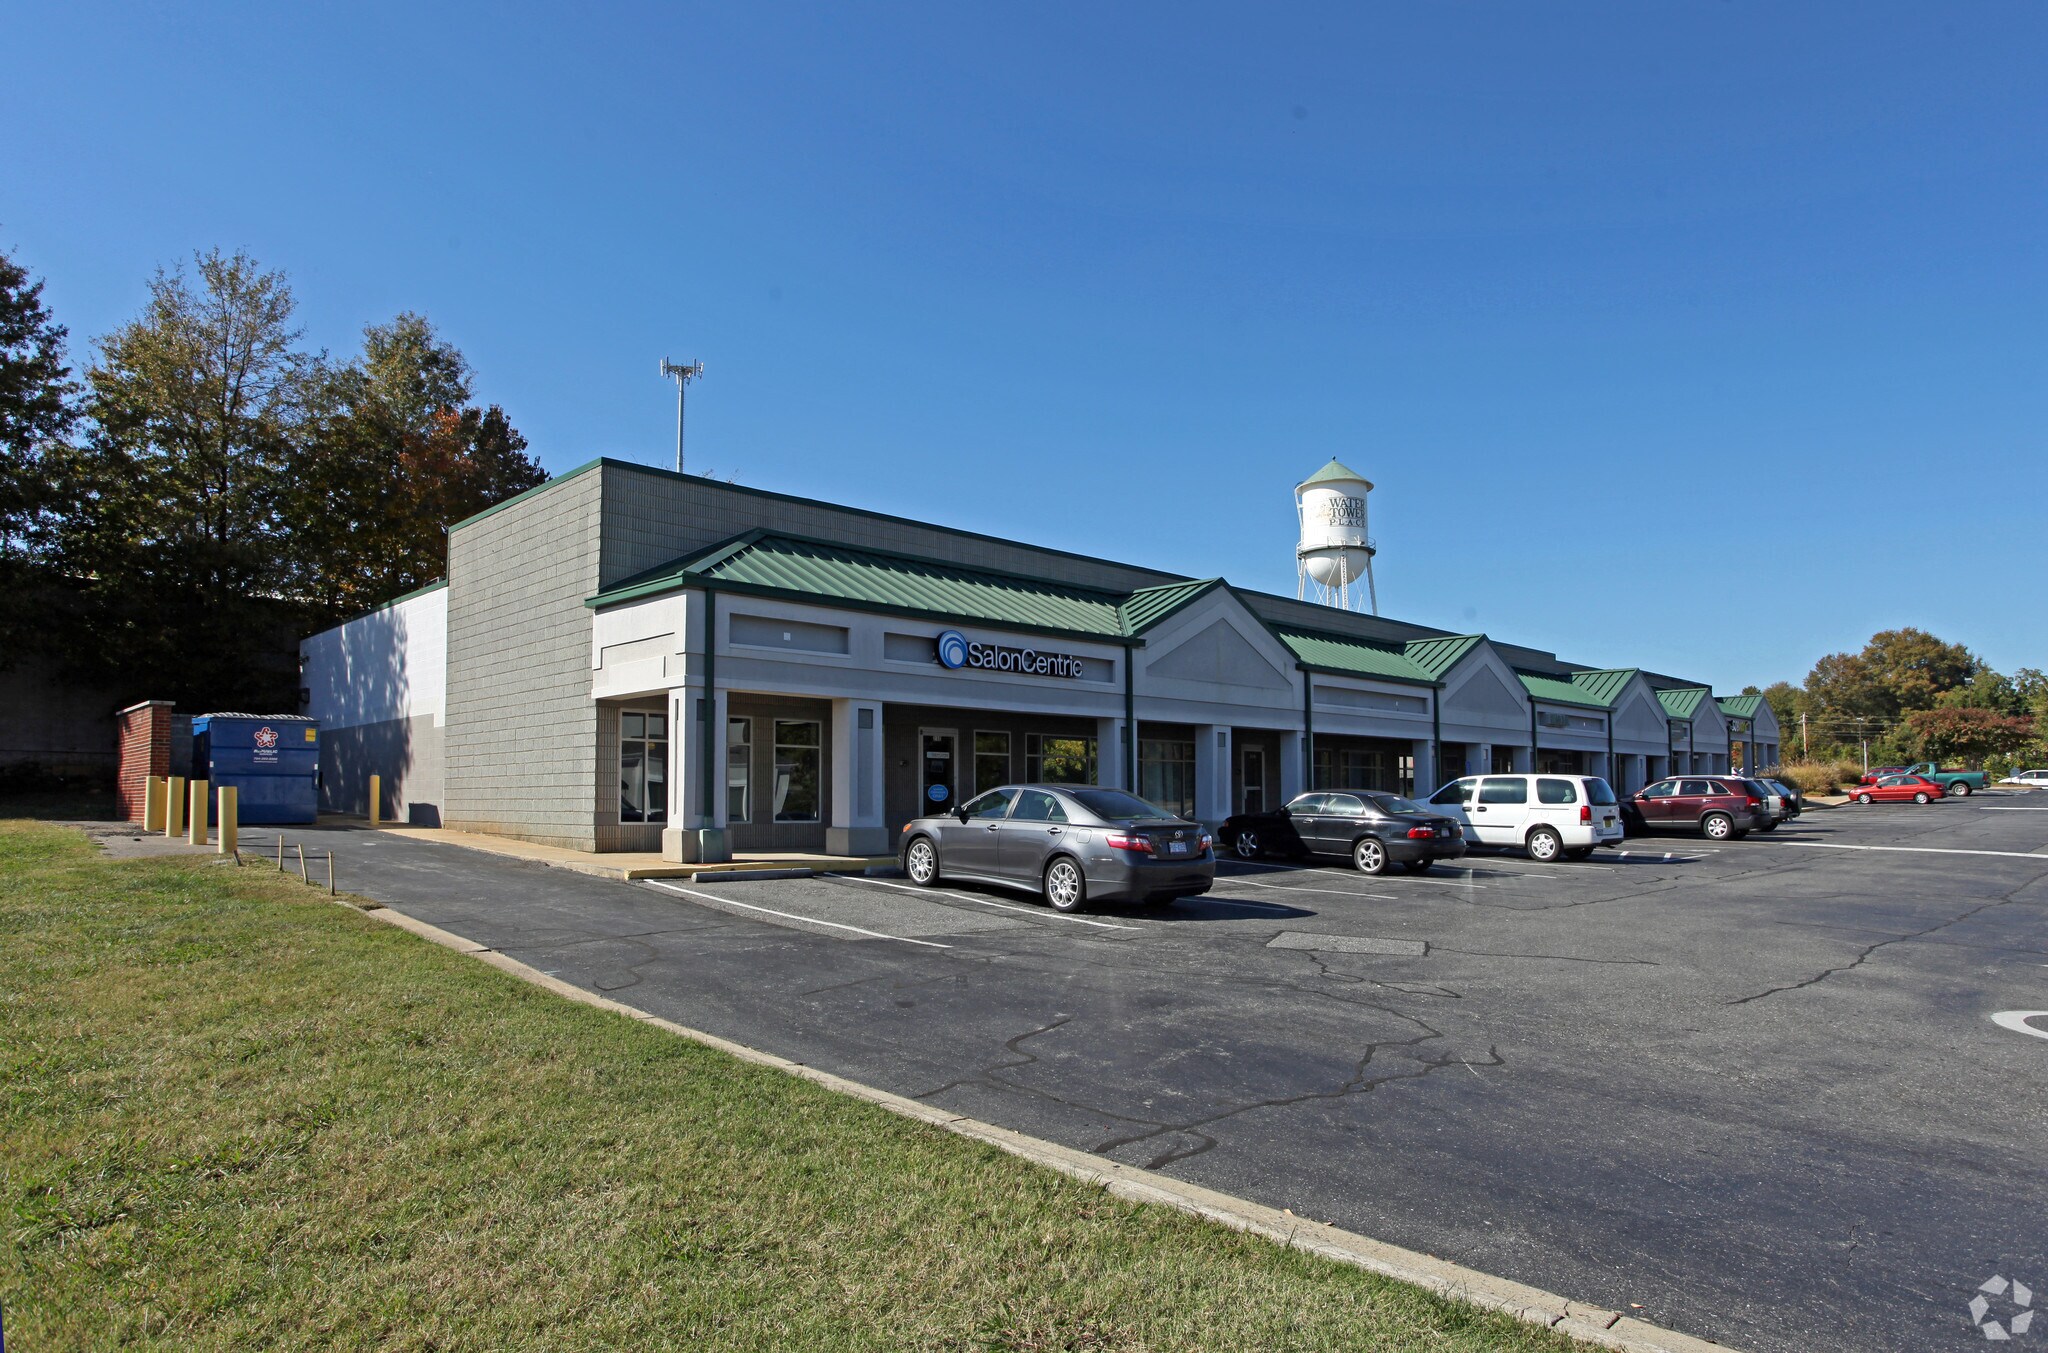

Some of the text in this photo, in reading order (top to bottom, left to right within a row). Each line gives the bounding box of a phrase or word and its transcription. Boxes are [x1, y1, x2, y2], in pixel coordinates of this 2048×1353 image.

[1329, 498, 1365, 509] WATER
[1329, 508, 1365, 519] TOWER
[968, 642, 1083, 677] SalonCentric
